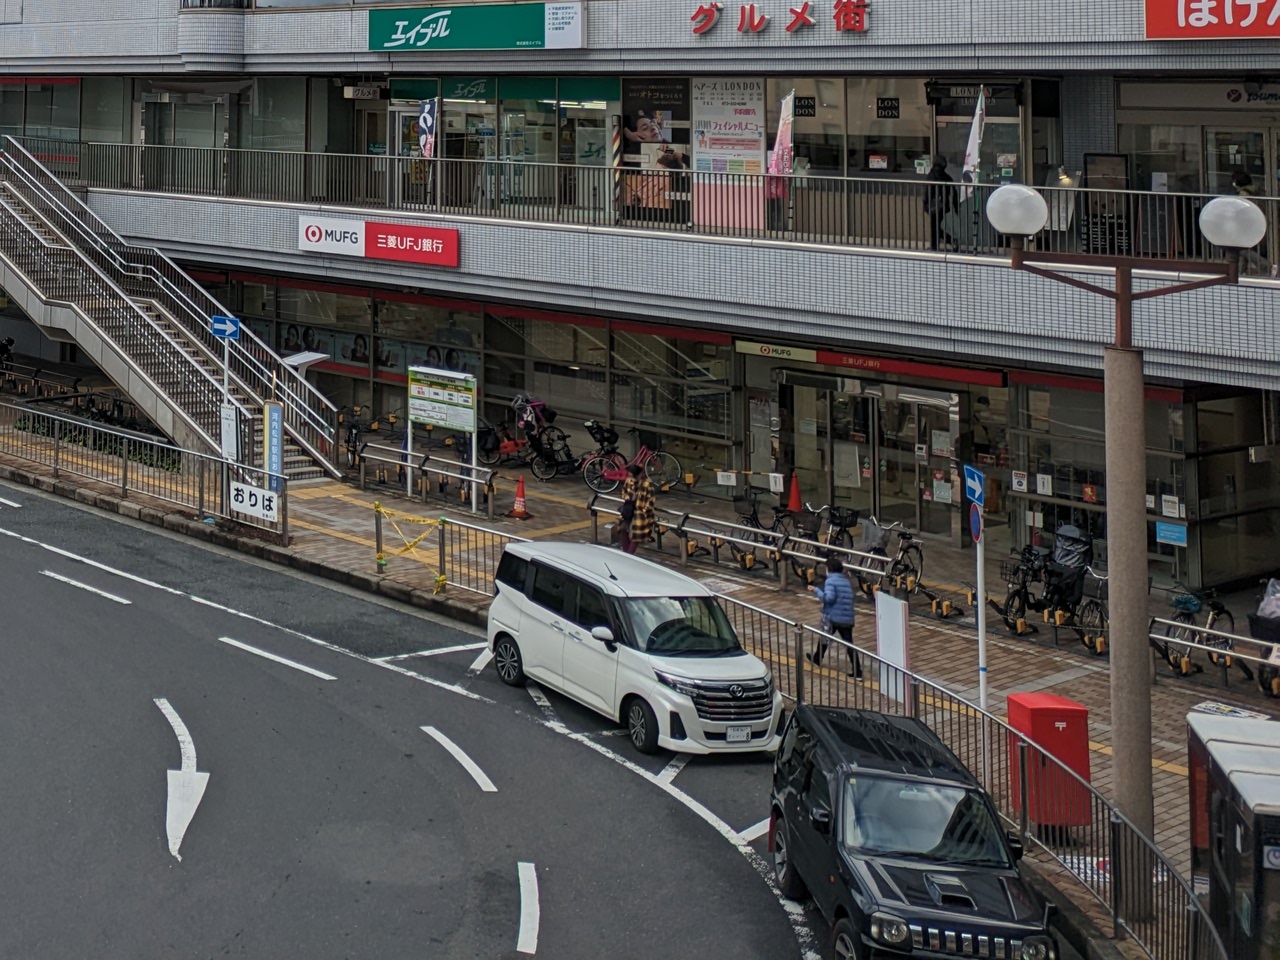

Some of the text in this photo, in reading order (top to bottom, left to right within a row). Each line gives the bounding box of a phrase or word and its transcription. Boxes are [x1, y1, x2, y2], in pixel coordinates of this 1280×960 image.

[383, 10, 452, 47] エイブル
[451, 79, 487, 97] エイブル
[724, 82, 761, 91] LONDON
[795, 98, 815, 106] LON
[878, 99, 899, 107] LON
[795, 108, 815, 116] DON
[878, 109, 899, 117] DON
[324, 229, 358, 244] MUFG
[377, 234, 443, 253] 三菱UFJ銀行
[771, 348, 791, 357] MUFG
[233, 487, 274, 512] おりば
